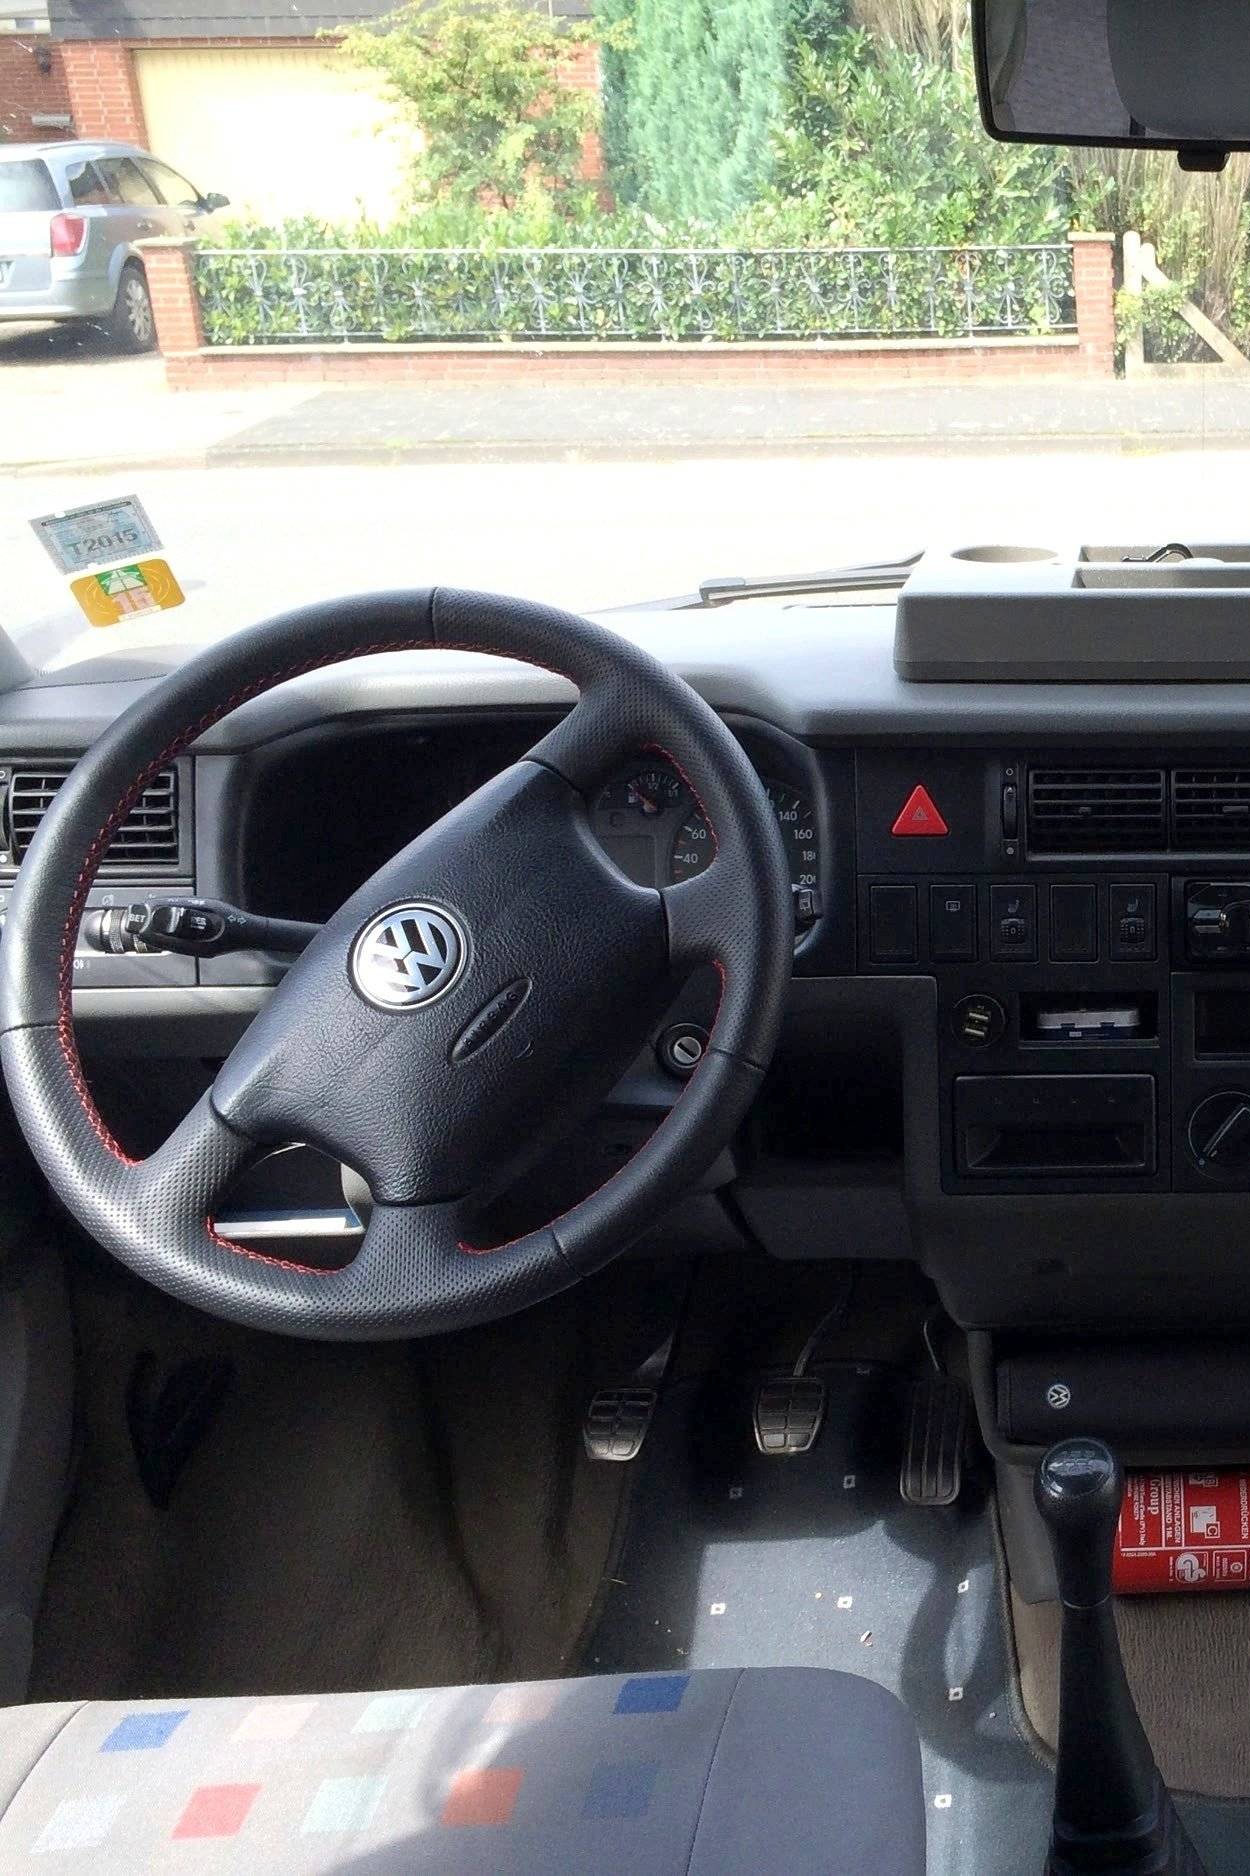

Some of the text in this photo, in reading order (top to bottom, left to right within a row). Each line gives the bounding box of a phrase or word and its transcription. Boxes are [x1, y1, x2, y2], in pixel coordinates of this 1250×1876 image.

[779, 811, 798, 821] 140
[691, 829, 706, 839] 60
[794, 829, 813, 840] 160
[683, 853, 698, 864] 40
[1147, 1478, 1161, 1515] Group
[1207, 1525, 1217, 1537] C
